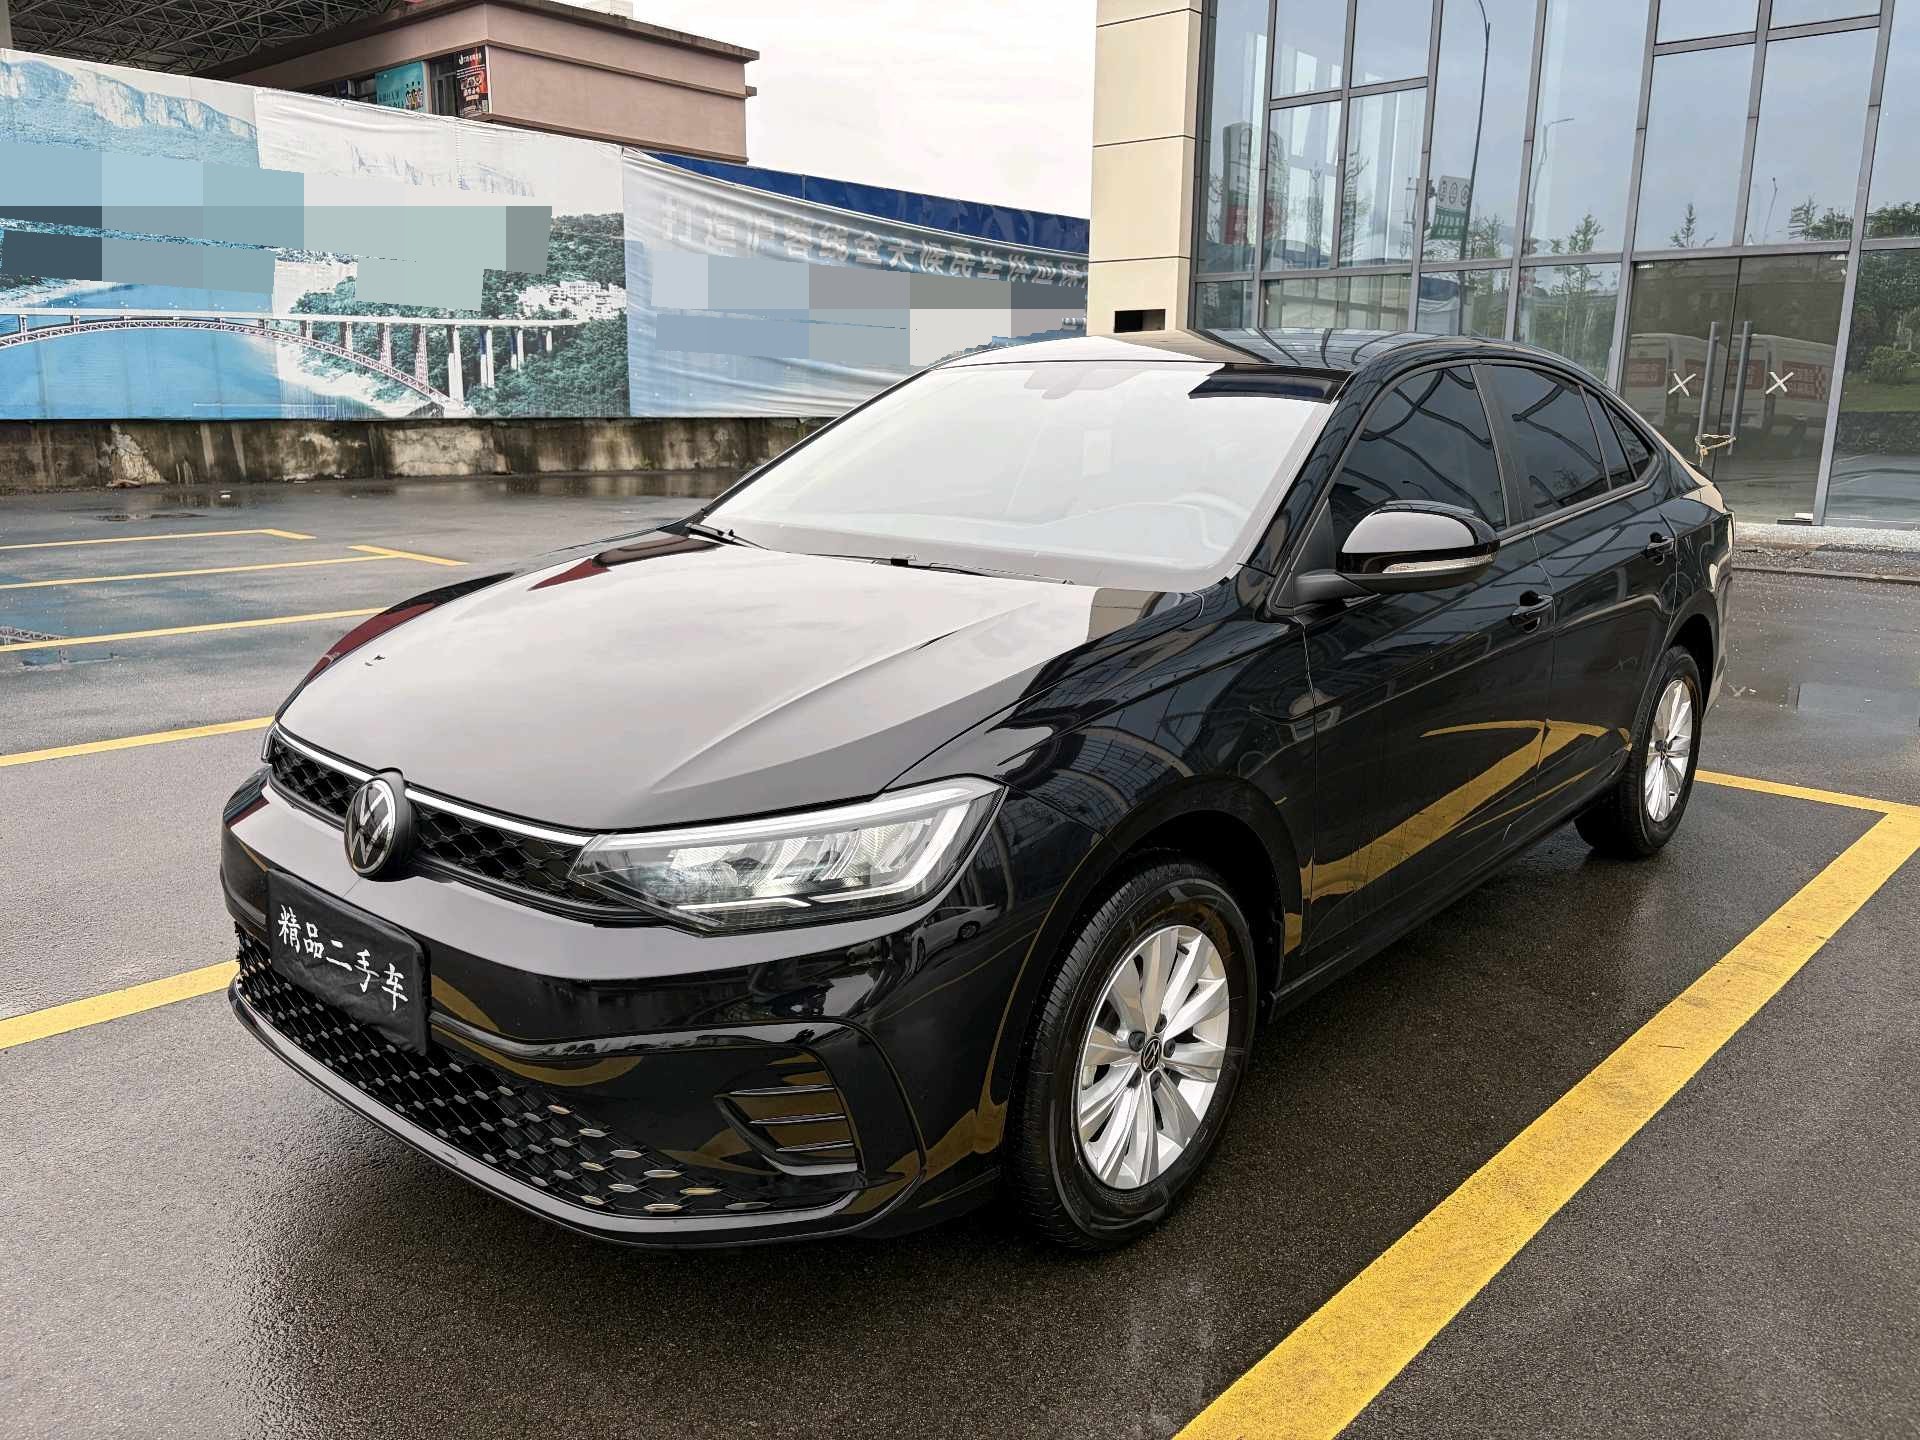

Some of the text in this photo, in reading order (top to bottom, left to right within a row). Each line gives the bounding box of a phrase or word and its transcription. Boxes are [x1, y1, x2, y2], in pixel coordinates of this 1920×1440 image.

[277, 904, 408, 1011] 精品二手车
